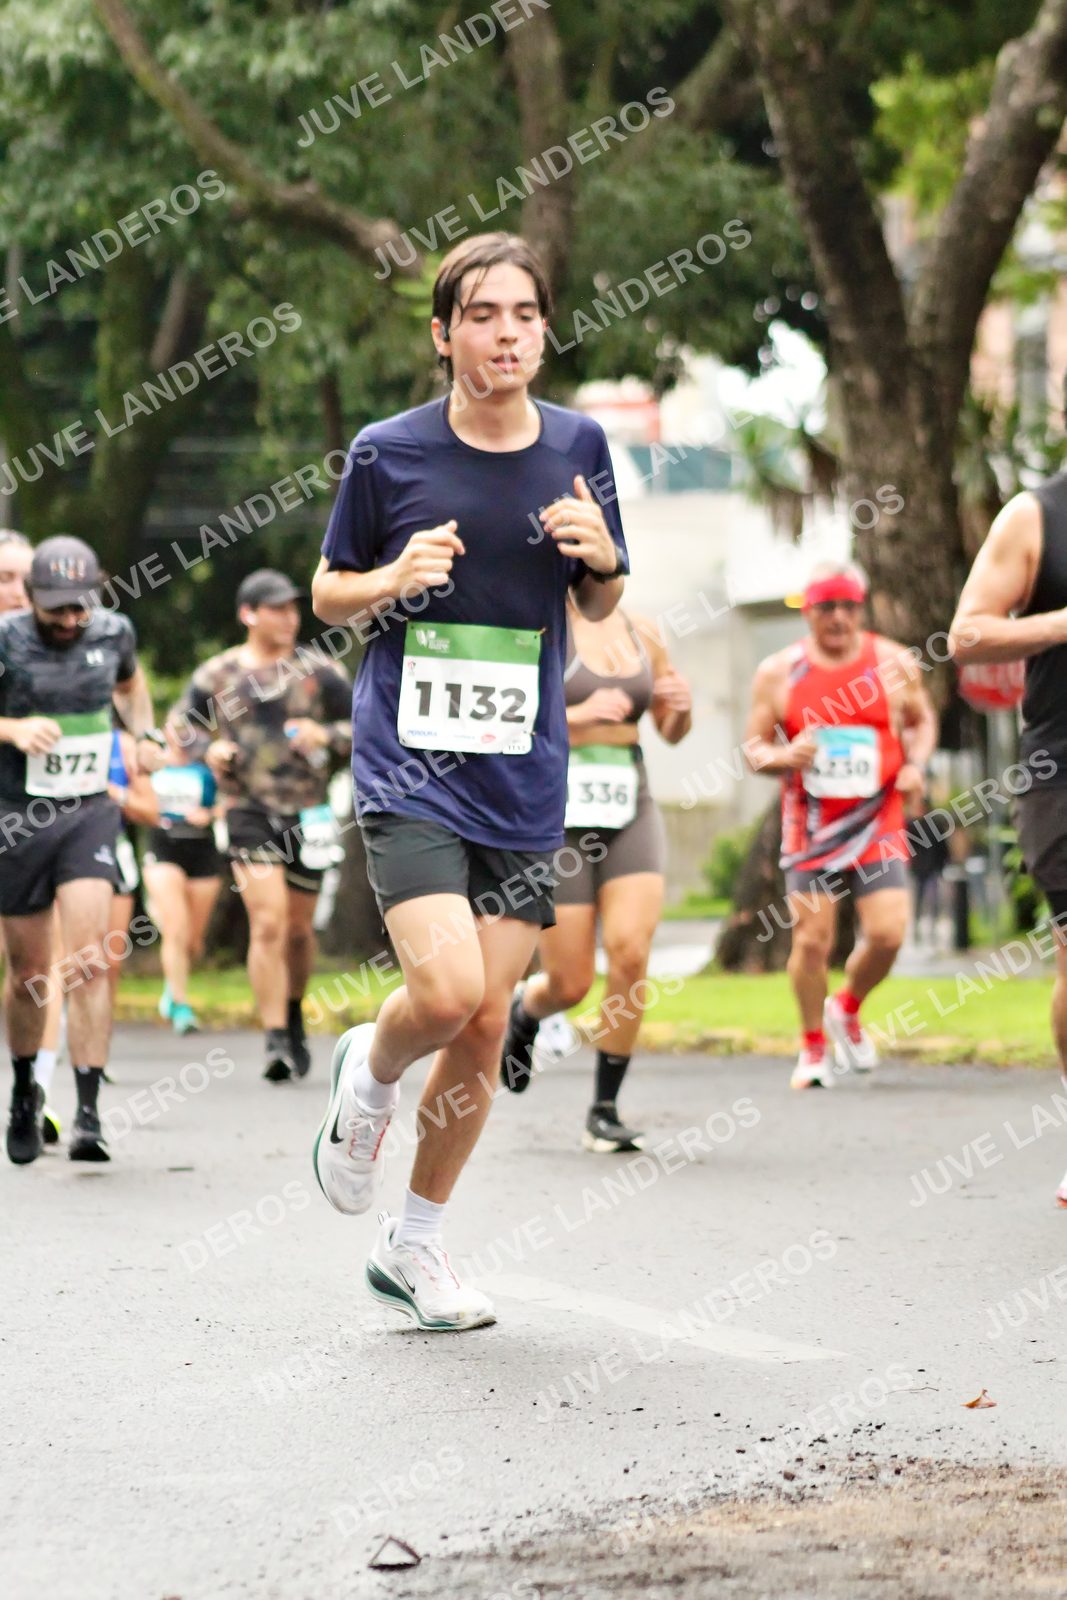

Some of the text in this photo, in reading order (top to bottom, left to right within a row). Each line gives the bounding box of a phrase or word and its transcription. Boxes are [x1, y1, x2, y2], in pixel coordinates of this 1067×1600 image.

[415, 681, 527, 723] 1132
[45, 752, 97, 775] 872
[567, 782, 628, 805] 336
